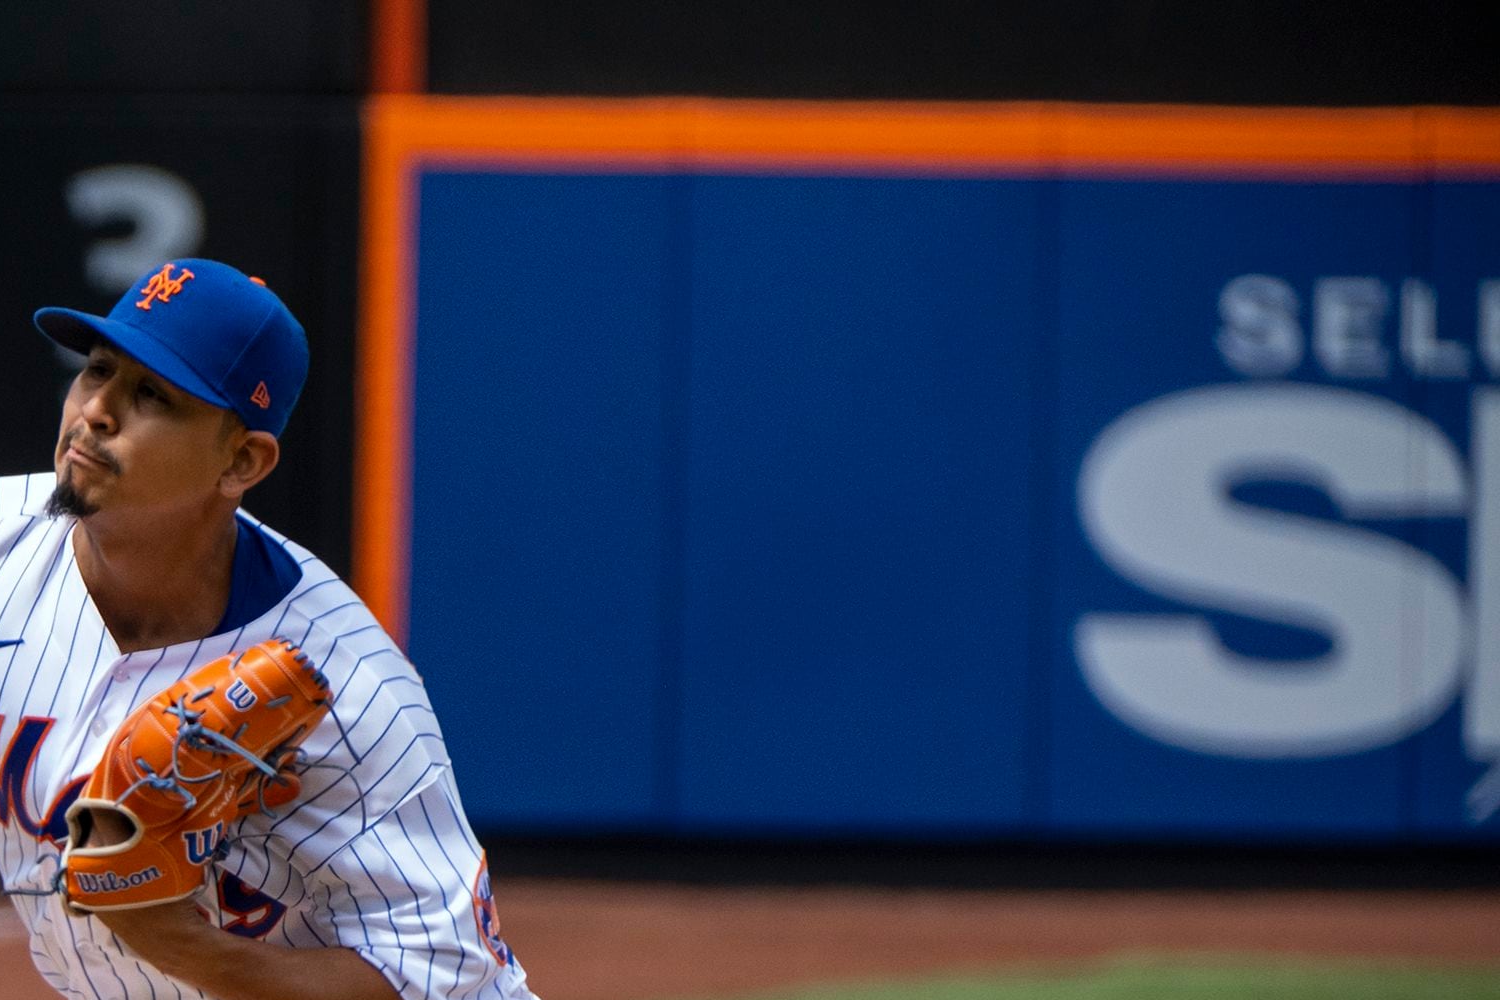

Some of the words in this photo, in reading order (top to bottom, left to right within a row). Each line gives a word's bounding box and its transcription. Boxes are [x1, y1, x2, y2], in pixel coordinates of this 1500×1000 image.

[1074, 379, 1500, 762] S
[225, 678, 257, 712] W
[73, 865, 162, 895] Wilson
